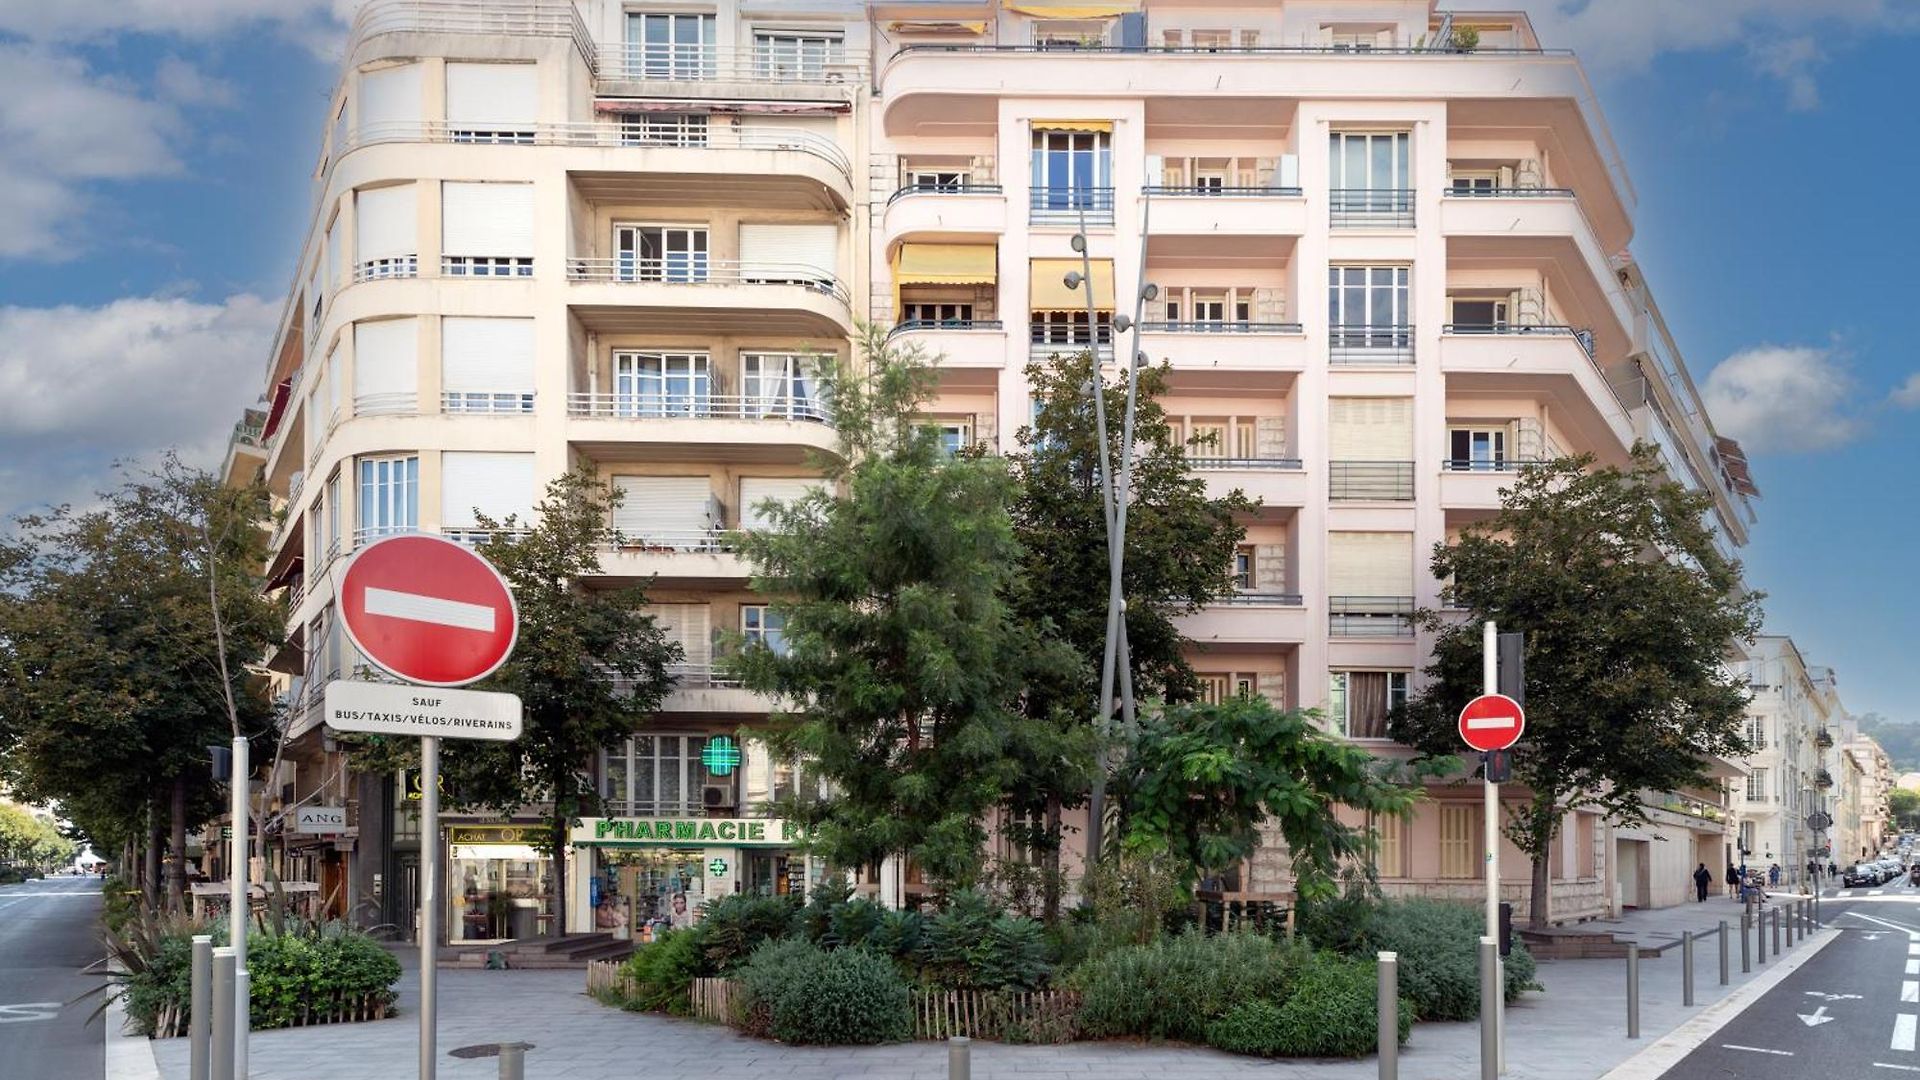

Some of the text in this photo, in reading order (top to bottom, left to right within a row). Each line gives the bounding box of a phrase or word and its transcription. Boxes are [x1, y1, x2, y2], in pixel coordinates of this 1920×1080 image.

[412, 697, 442, 707] SAUF
[335, 710, 512, 730] BUS/TAXIS/VÉLOS/RIVERAINS
[595, 819, 765, 841] PHARMACIE
